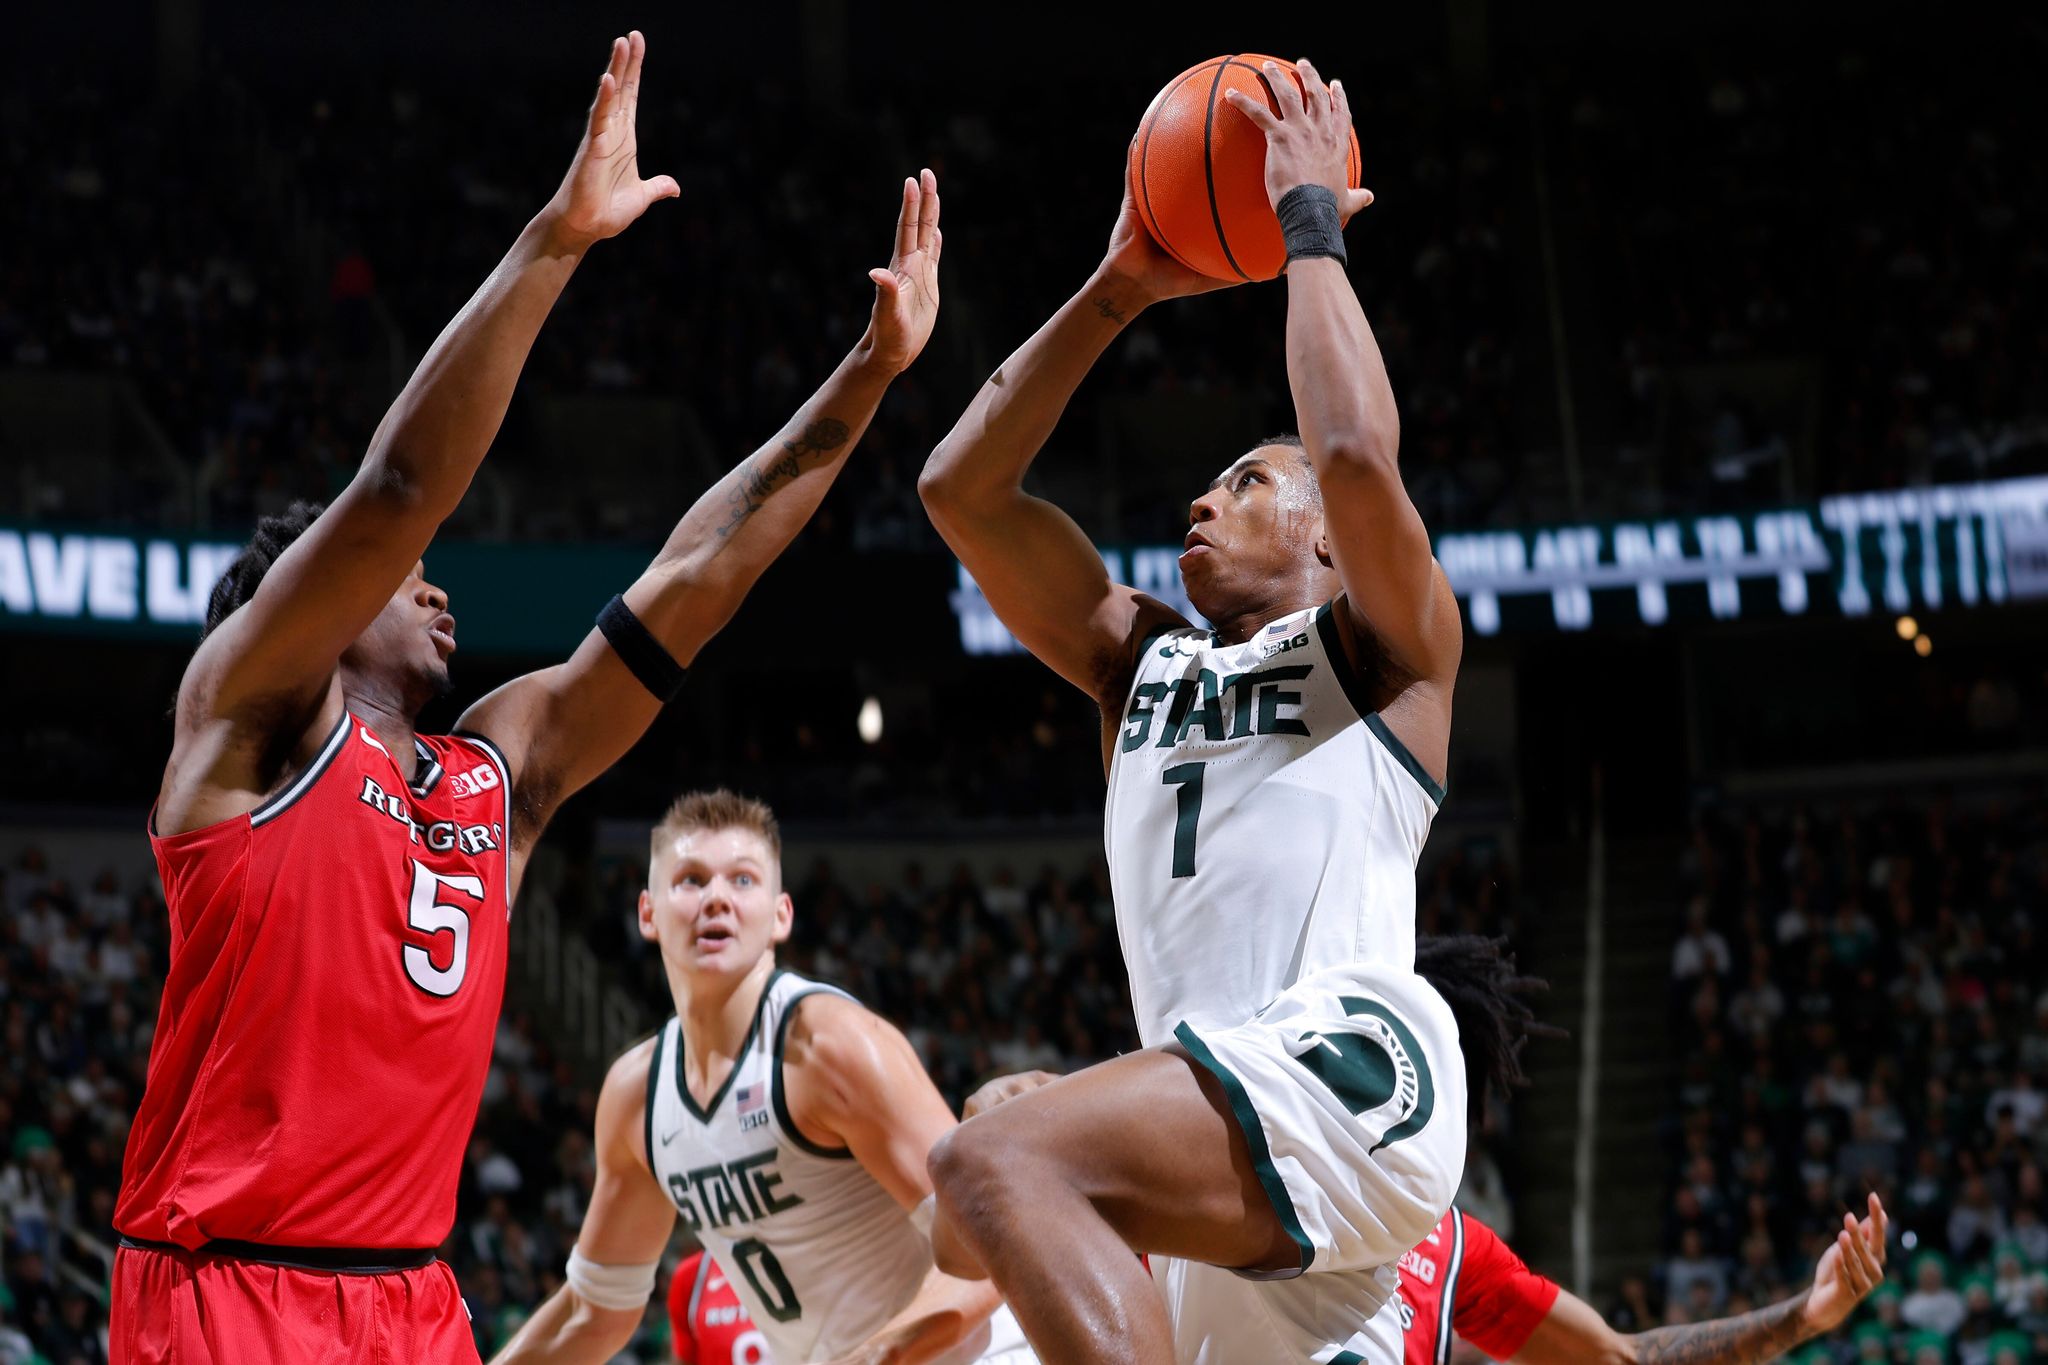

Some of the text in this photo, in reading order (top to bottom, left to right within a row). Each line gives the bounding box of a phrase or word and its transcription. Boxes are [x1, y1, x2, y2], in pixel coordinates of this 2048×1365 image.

[1122, 664, 1314, 753] STATE
[1162, 761, 1206, 879] 1
[402, 857, 485, 997] 5
[668, 1147, 805, 1231] STATE
[732, 1237, 802, 1323] 0
